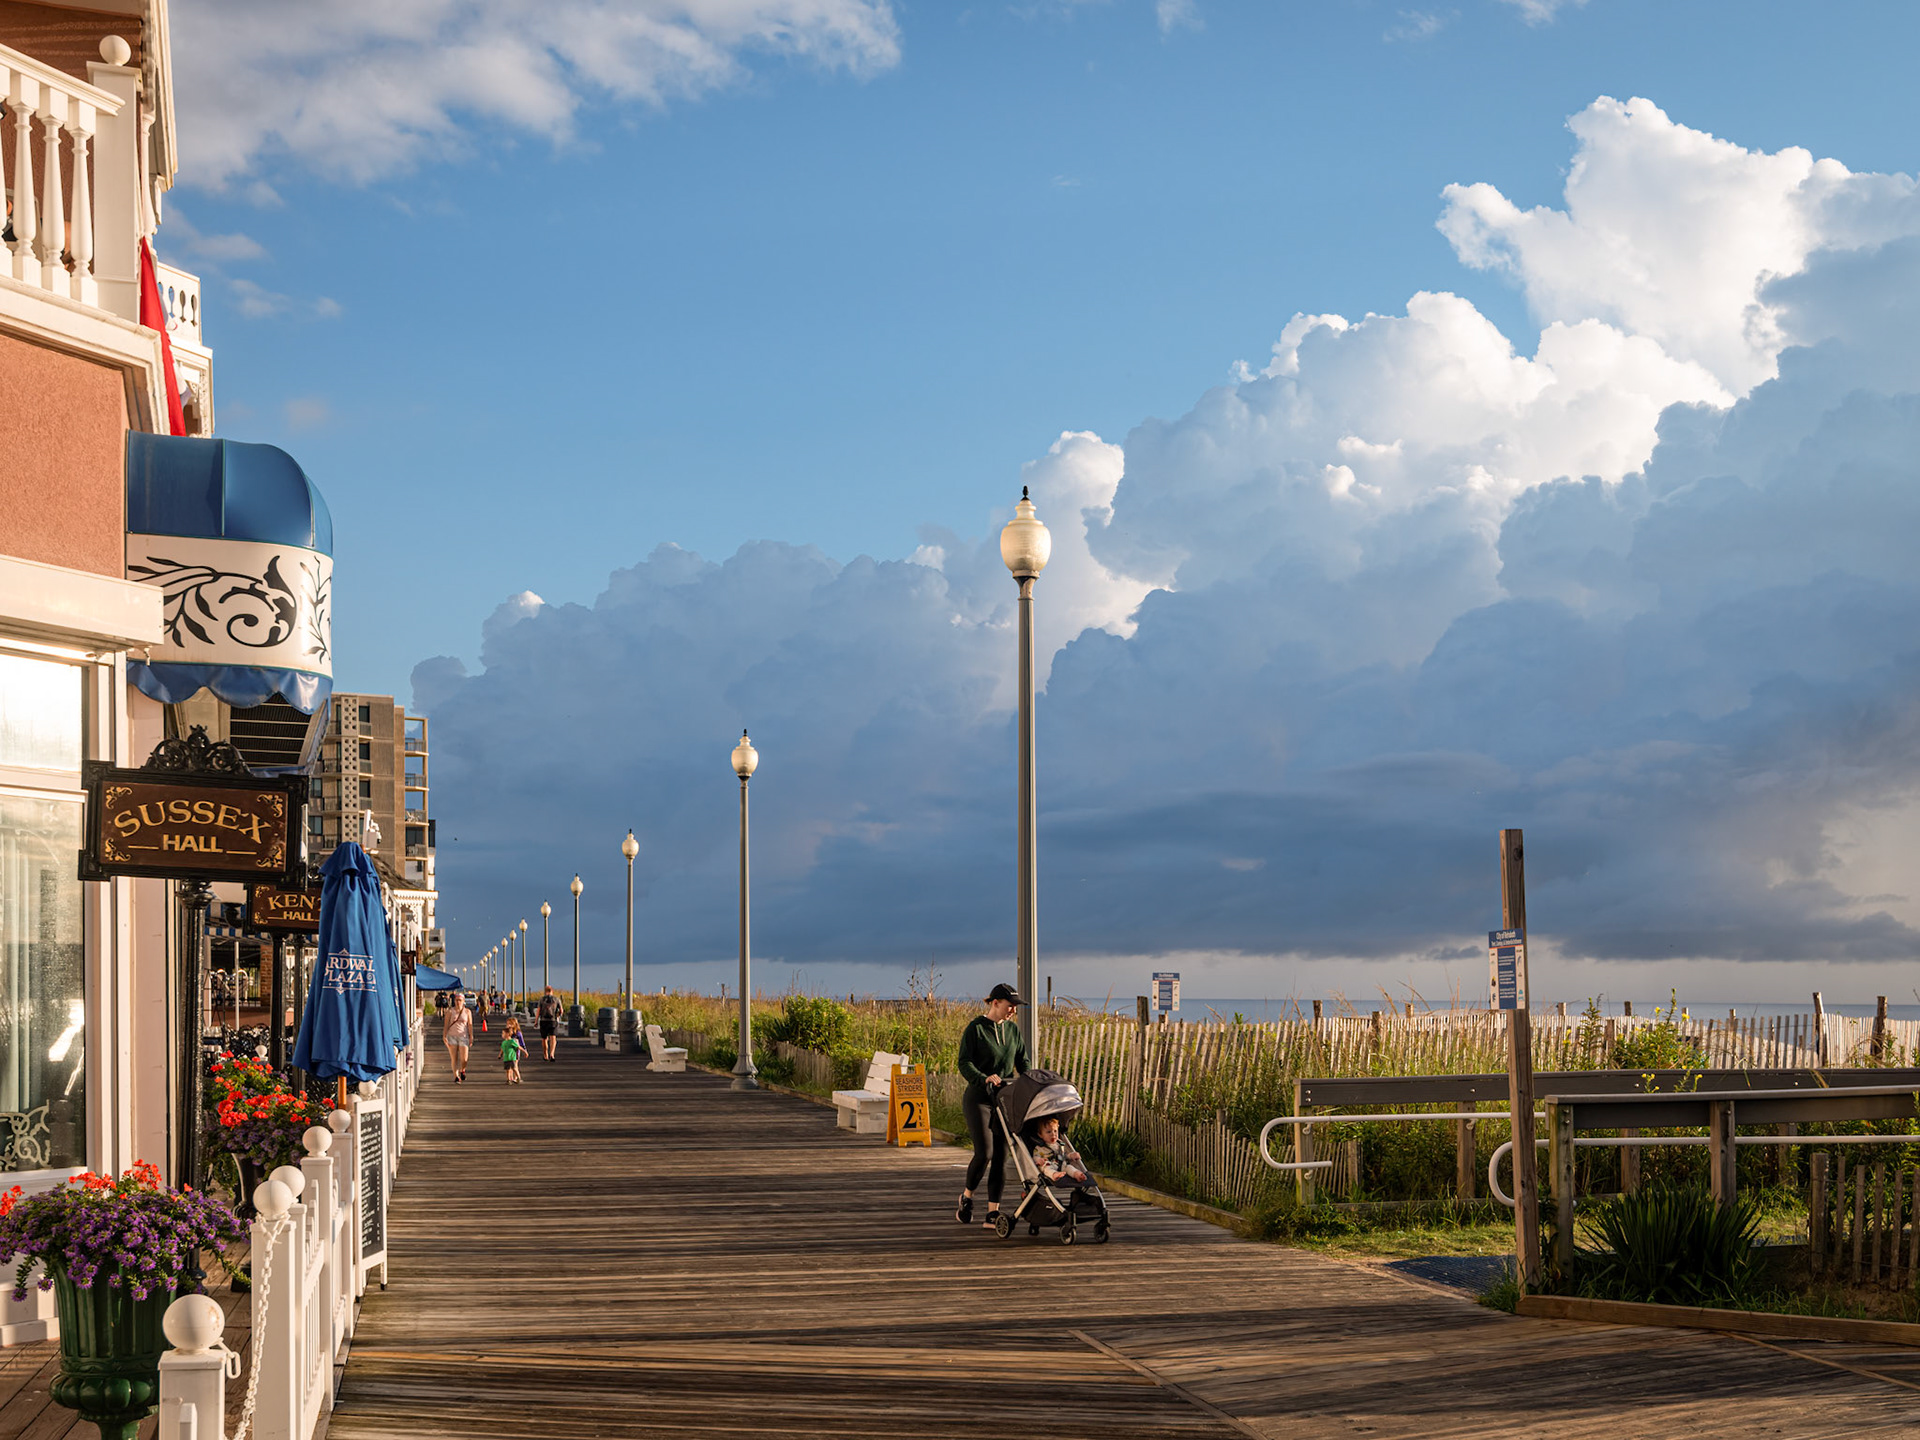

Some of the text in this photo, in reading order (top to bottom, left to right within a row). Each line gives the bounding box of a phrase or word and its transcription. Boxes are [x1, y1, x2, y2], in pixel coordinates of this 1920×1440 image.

[114, 799, 272, 845] SUSSEX
[162, 834, 224, 853] HALL
[283, 911, 315, 922] HALL
[897, 1085, 923, 1093] STRIDERS
[900, 1101, 917, 1128] 2
